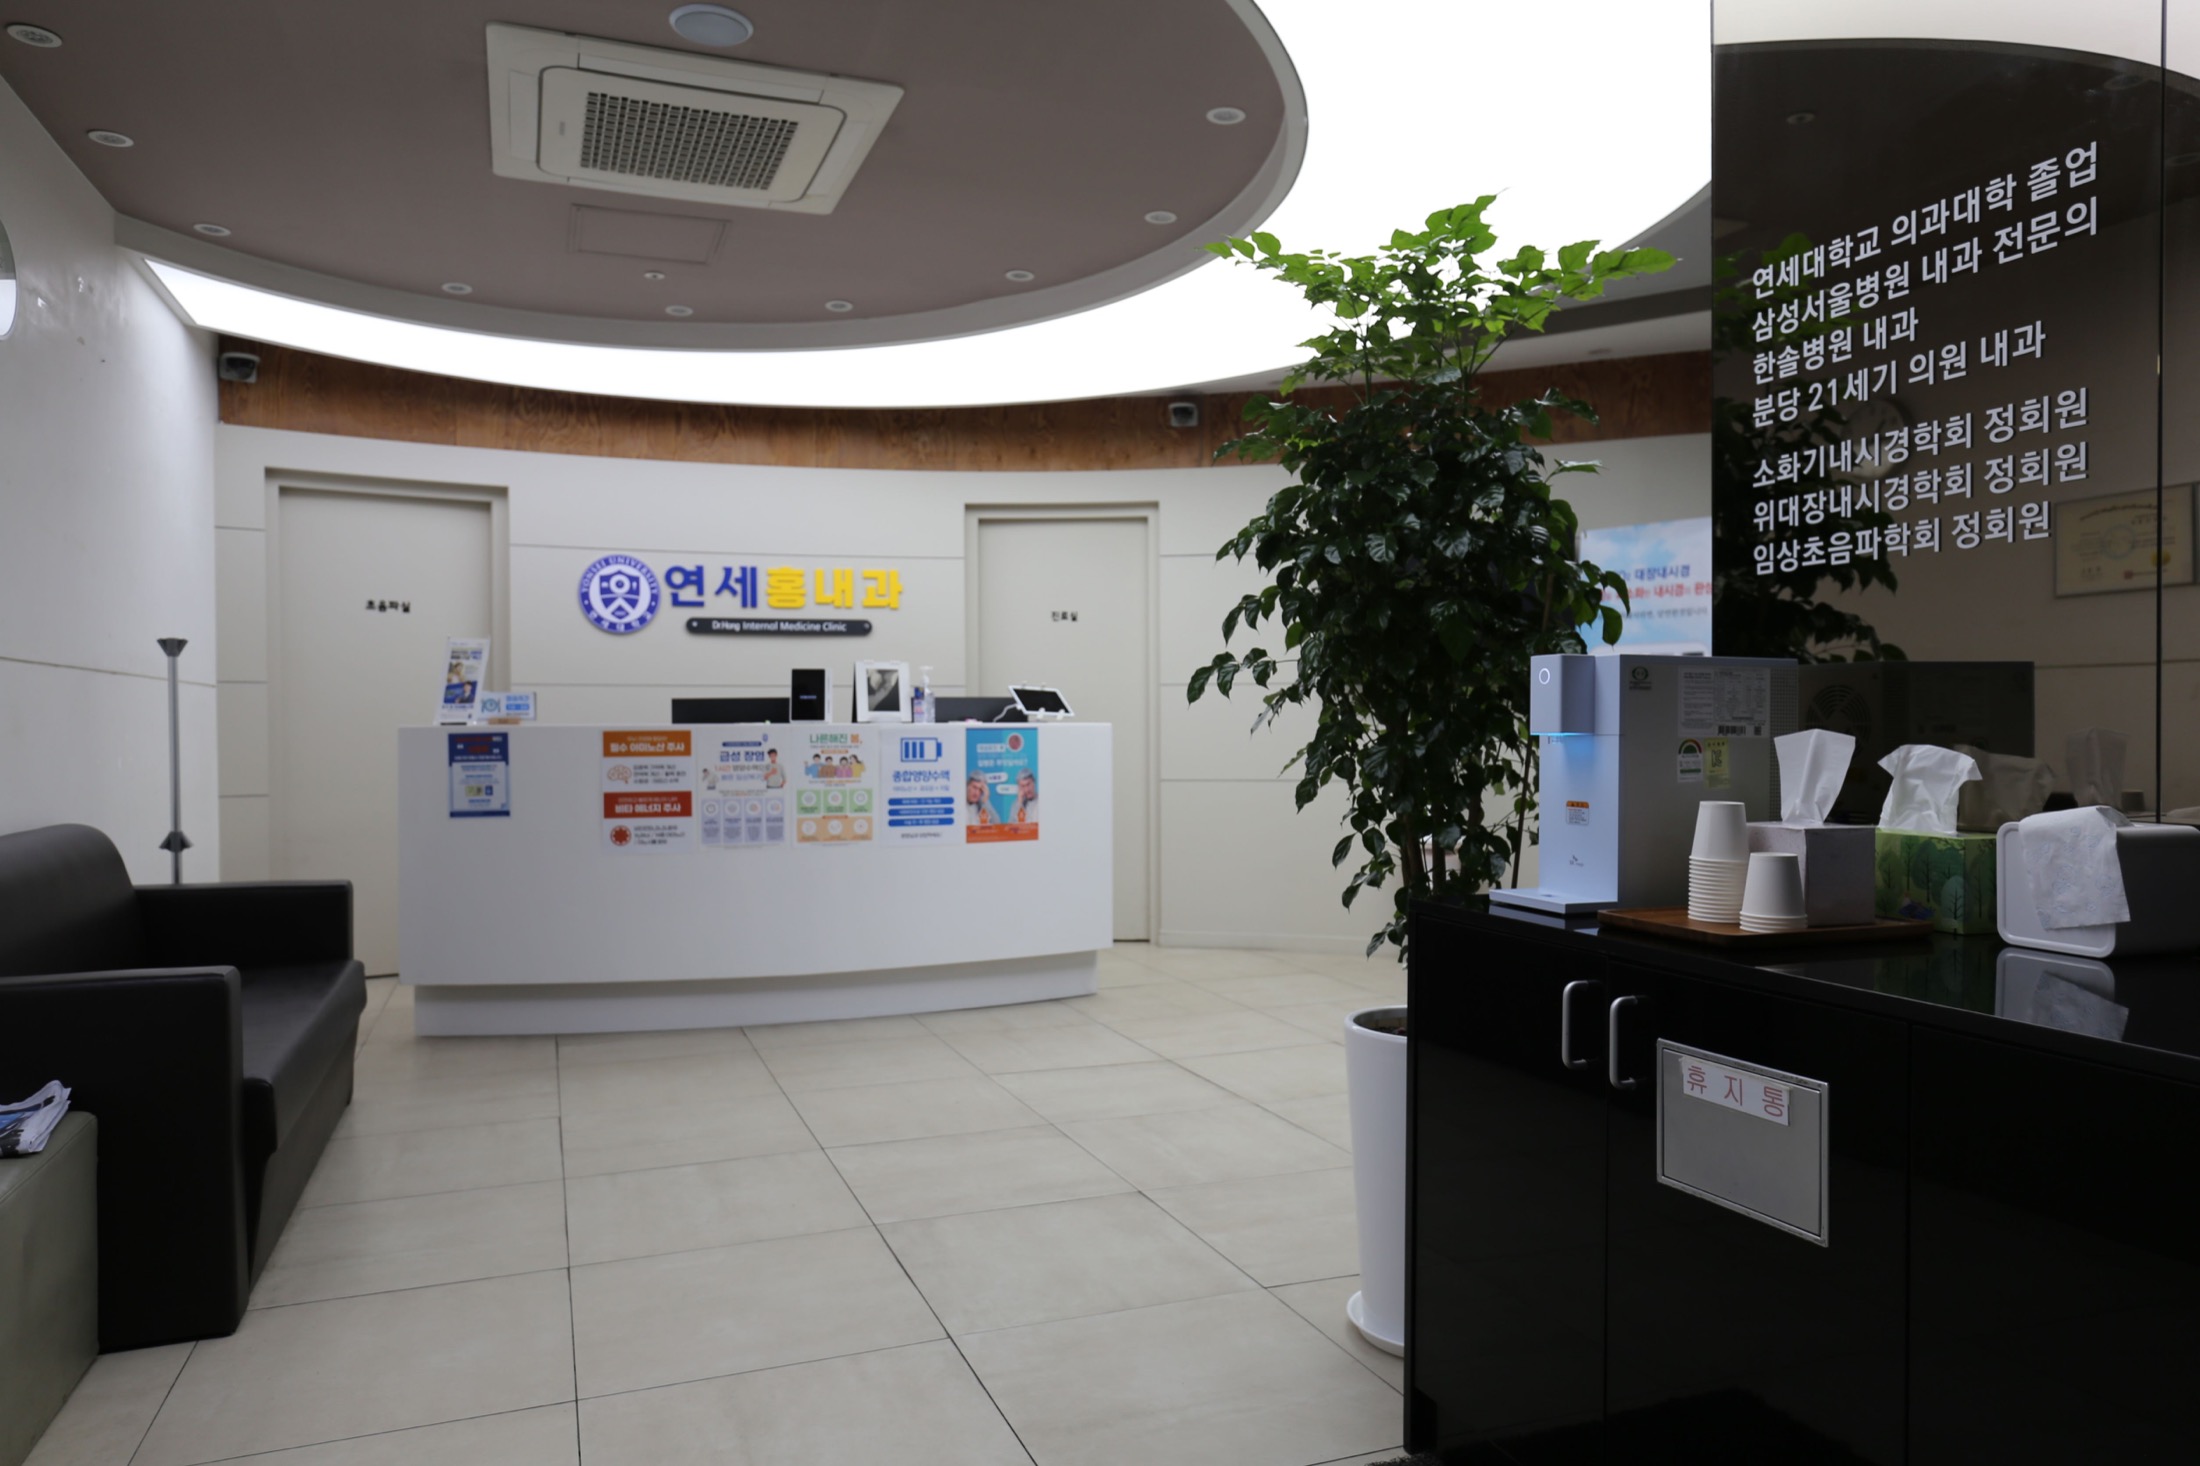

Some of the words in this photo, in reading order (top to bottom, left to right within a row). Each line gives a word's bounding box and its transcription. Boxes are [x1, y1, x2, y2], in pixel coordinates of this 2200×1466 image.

[1753, 226, 1882, 299] 연세대학교
[1891, 174, 2017, 245] 의과대학
[2027, 142, 2097, 202] 졸업
[1753, 261, 1910, 342] 삼성서울병원
[1922, 237, 1982, 283] 내과
[1993, 197, 2097, 264] 전문의
[1753, 326, 1852, 385] 한솔병원
[1863, 307, 1919, 349] 내과
[1753, 387, 1801, 428] 분당
[1808, 360, 1897, 412] 21세기
[1908, 341, 1967, 385] 의원
[1981, 321, 2046, 366] 내과
[1753, 412, 1973, 488] 소화기내시경학회
[1984, 388, 2087, 443] 정회원
[1753, 462, 1972, 532] 위대장내시경학회
[1984, 441, 2087, 495] 정회원
[1753, 516, 1941, 575] 임상초음파학회
[1952, 501, 2049, 549] 정회원
[742, 621, 778, 631] Internal
[779, 622, 821, 632] Medicine
[822, 622, 847, 632] Clinic
[893, 770, 950, 783] 종합영양수액
